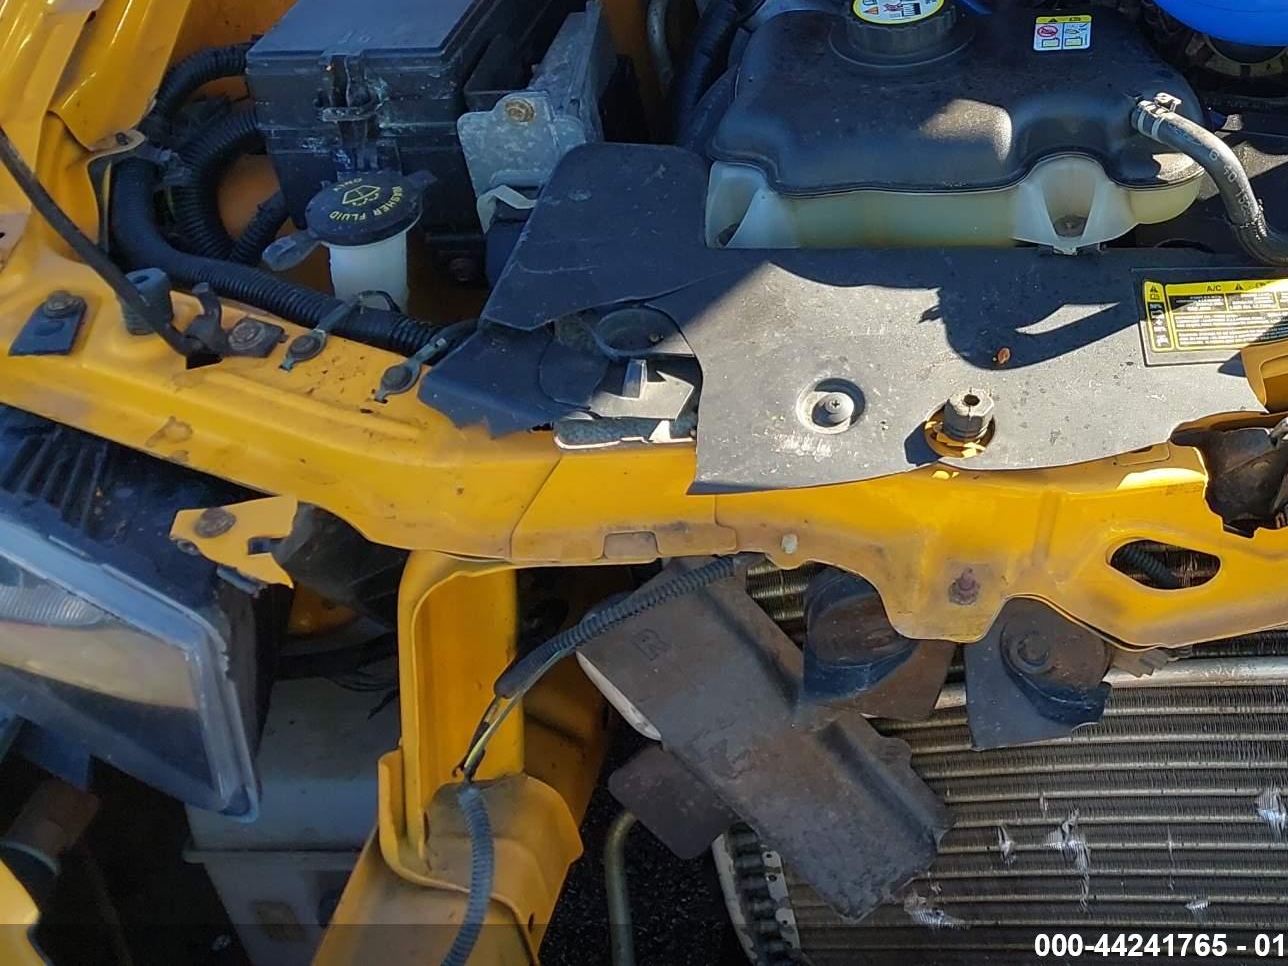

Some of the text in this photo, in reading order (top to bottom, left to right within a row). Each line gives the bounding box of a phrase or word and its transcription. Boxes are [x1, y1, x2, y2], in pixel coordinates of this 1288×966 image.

[373, 186, 402, 215] WASHER
[329, 211, 367, 220] FLUID
[1206, 284, 1222, 293] A/C
